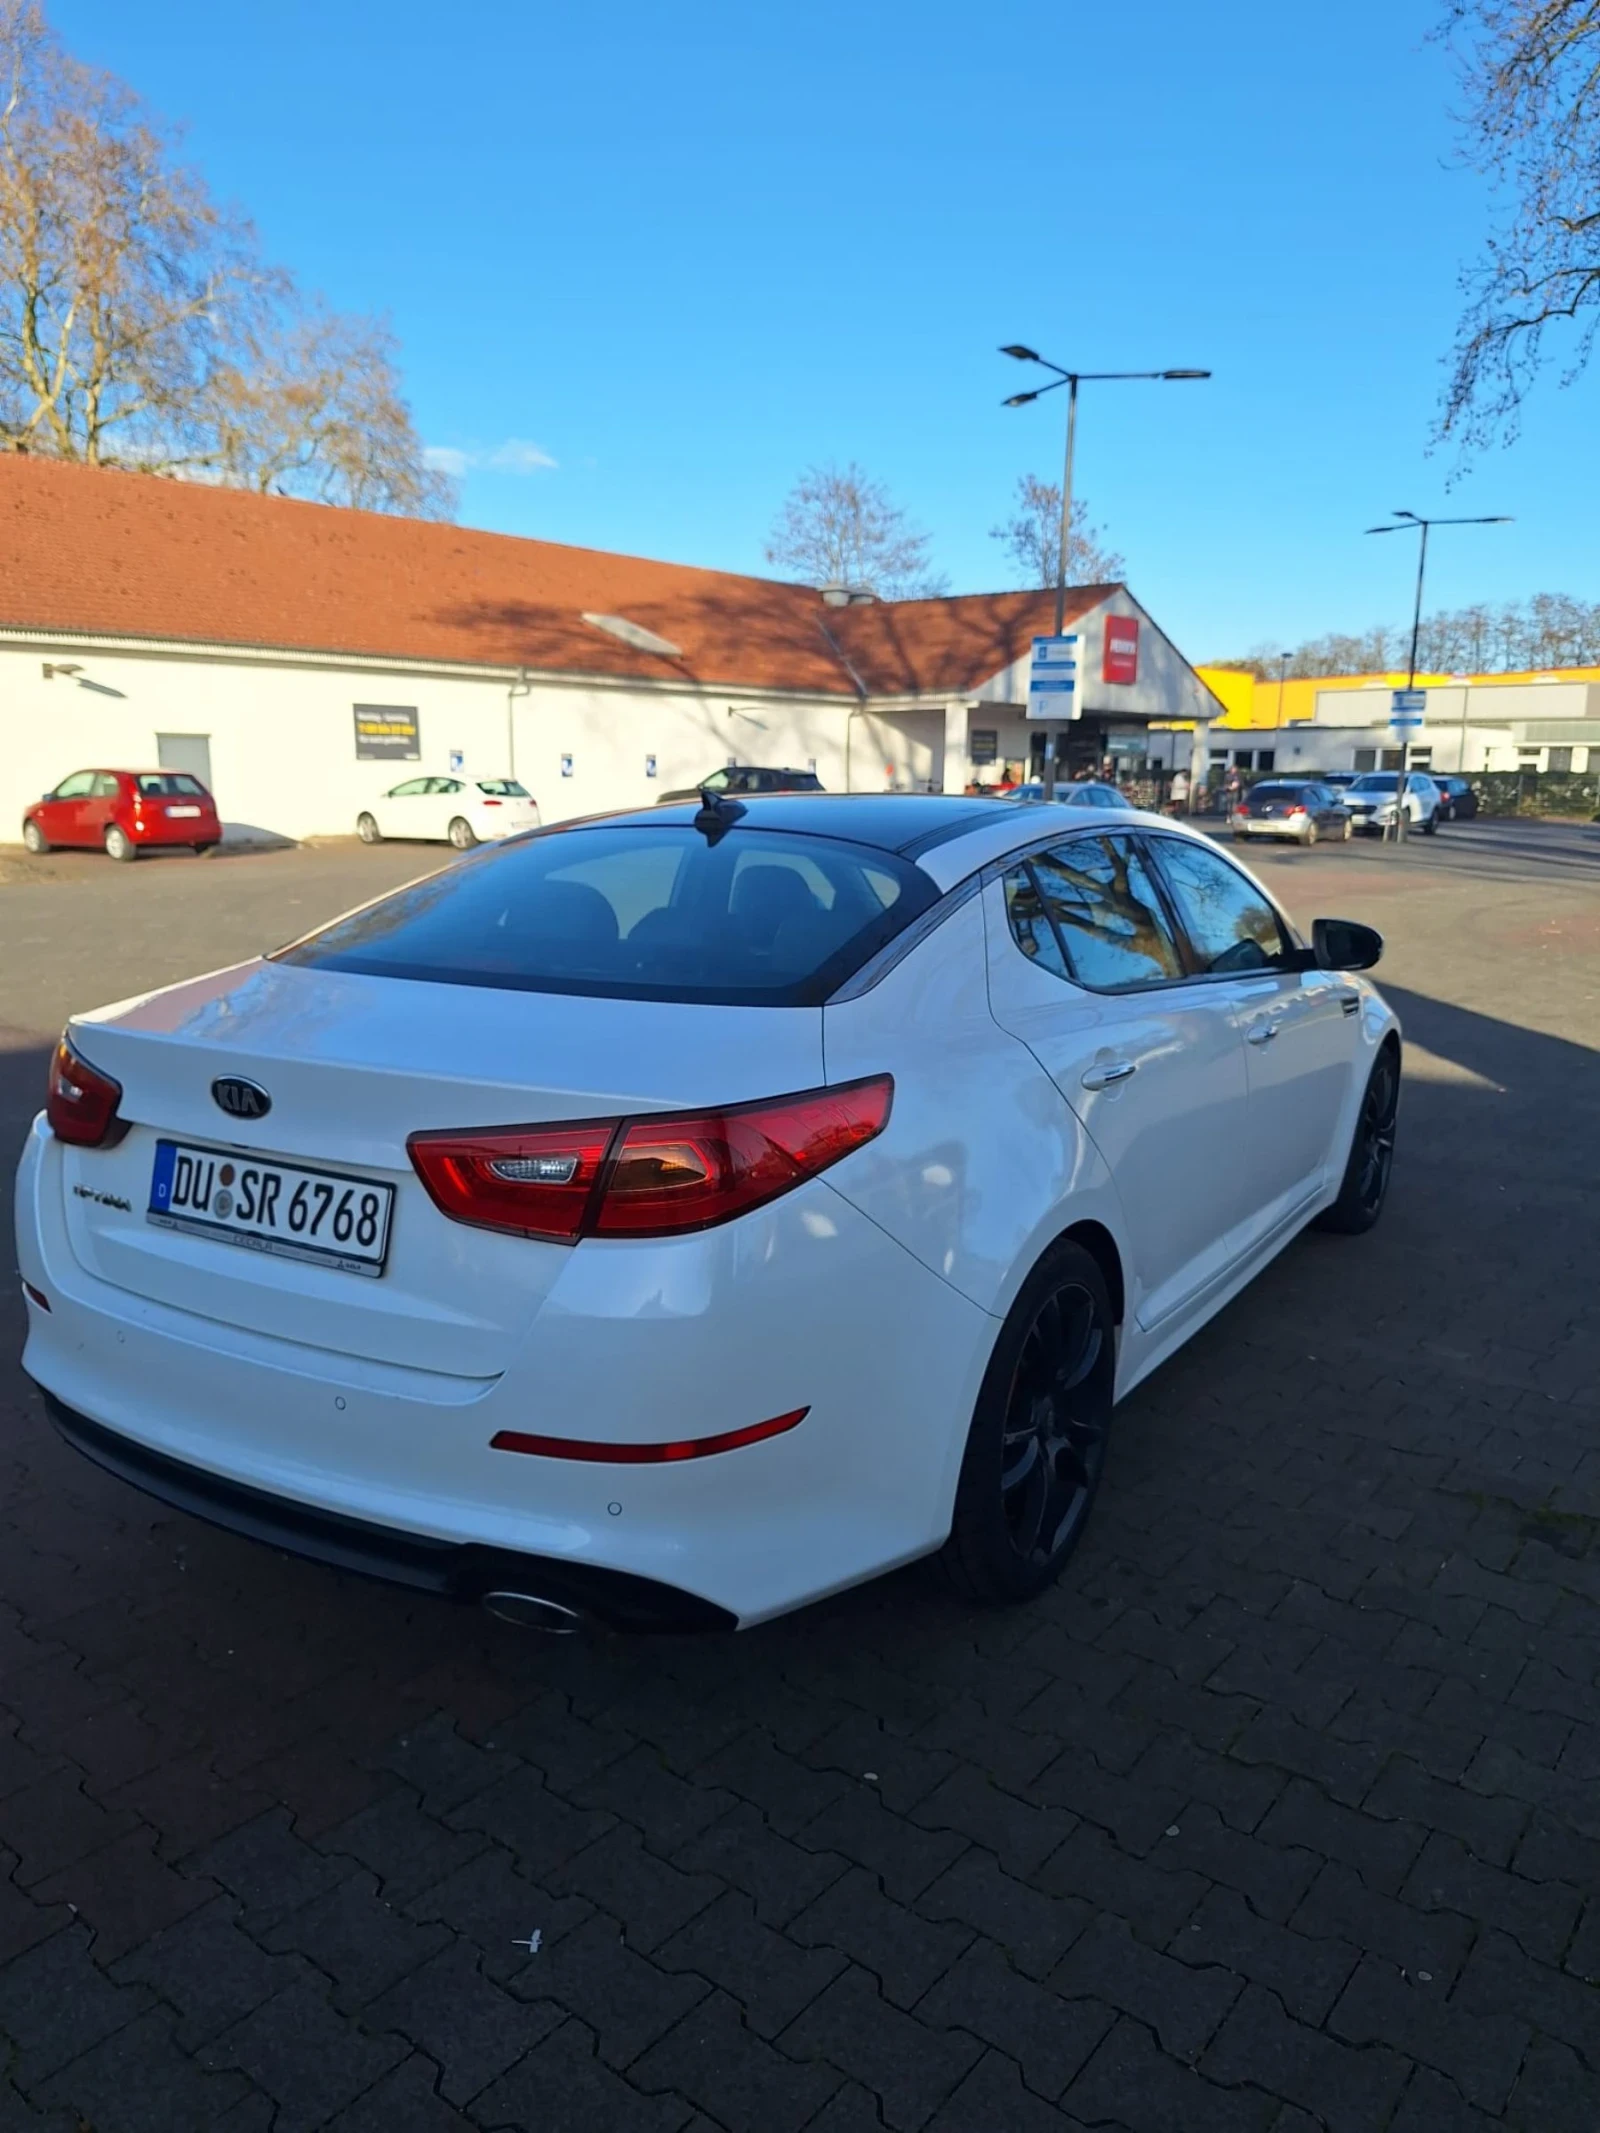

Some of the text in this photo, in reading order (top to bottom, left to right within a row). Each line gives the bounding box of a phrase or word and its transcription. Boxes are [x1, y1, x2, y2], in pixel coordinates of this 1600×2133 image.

[217, 1083, 260, 1113] KIA
[158, 1183, 167, 1198] D
[171, 1156, 214, 1211] DU
[236, 1169, 282, 1228] SR
[288, 1179, 380, 1247] 6768
